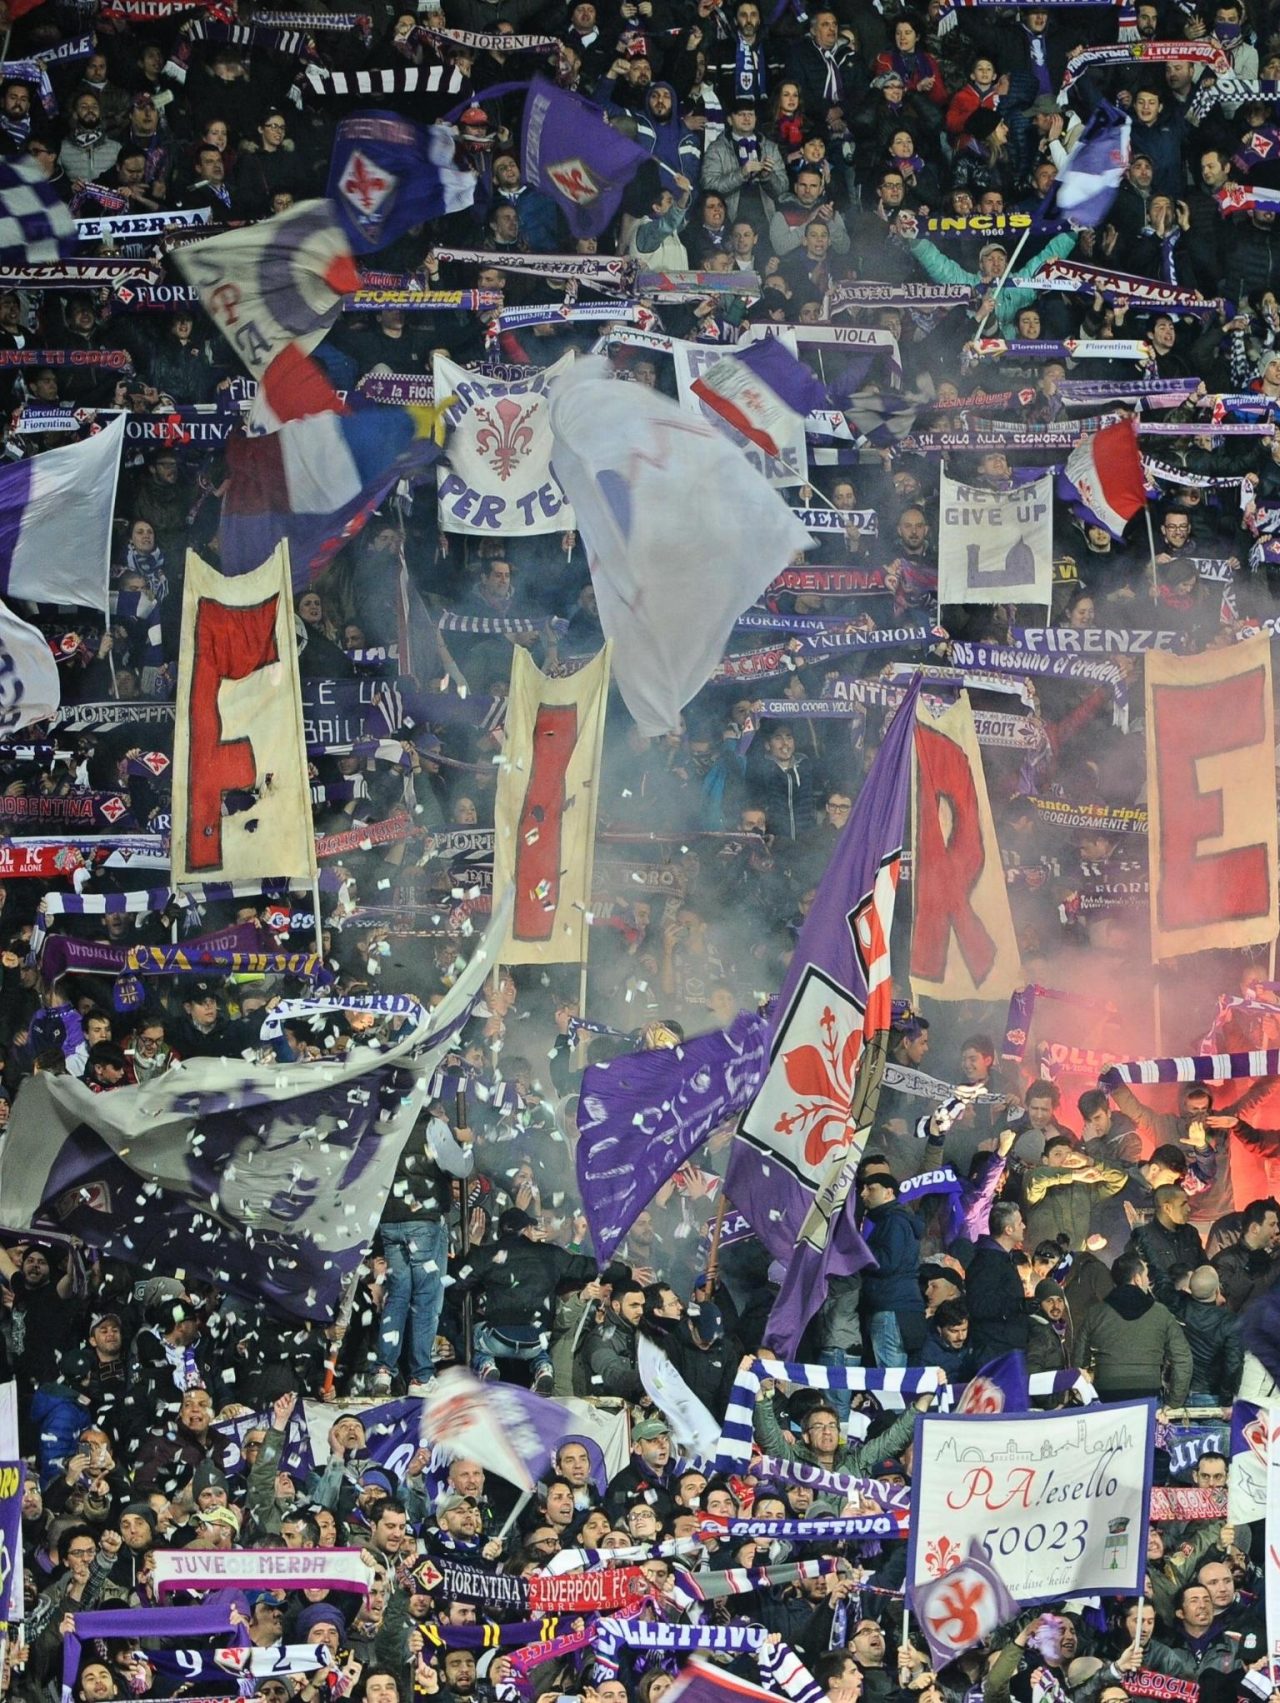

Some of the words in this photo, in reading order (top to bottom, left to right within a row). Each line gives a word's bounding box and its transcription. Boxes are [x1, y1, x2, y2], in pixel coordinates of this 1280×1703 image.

[1148, 46, 1217, 68] LIVERPOOL
[928, 214, 1033, 231] INCIS
[834, 328, 878, 344] VIOLA
[1010, 341, 1059, 351] Fiorentina
[1084, 340, 1133, 352] Fiorentina
[23, 408, 73, 420] Fiorentina
[23, 420, 73, 431] Fiorentina
[941, 433, 971, 447] CULO
[440, 473, 506, 529] PER
[944, 504, 1003, 527] GIVE
[1016, 503, 1047, 525] UP
[738, 614, 826, 630] FIORENTINA
[806, 629, 928, 652] FIORENTINA
[978, 650, 987, 665] e
[991, 648, 1049, 672] nessuno
[769, 701, 798, 713] CENTRO
[833, 701, 854, 713] VIOLA
[27, 848, 43, 869] FC
[21, 863, 43, 874] ALONE
[731, 1517, 892, 1536] COLLETTIVO
[982, 1518, 1089, 1563] 50023
[171, 1555, 226, 1575] JUVE
[259, 1554, 326, 1575] MERDA
[443, 1571, 521, 1601] FIORENTINA
[540, 1577, 606, 1603] LIVERPOOL
[612, 1574, 627, 1599] FC
